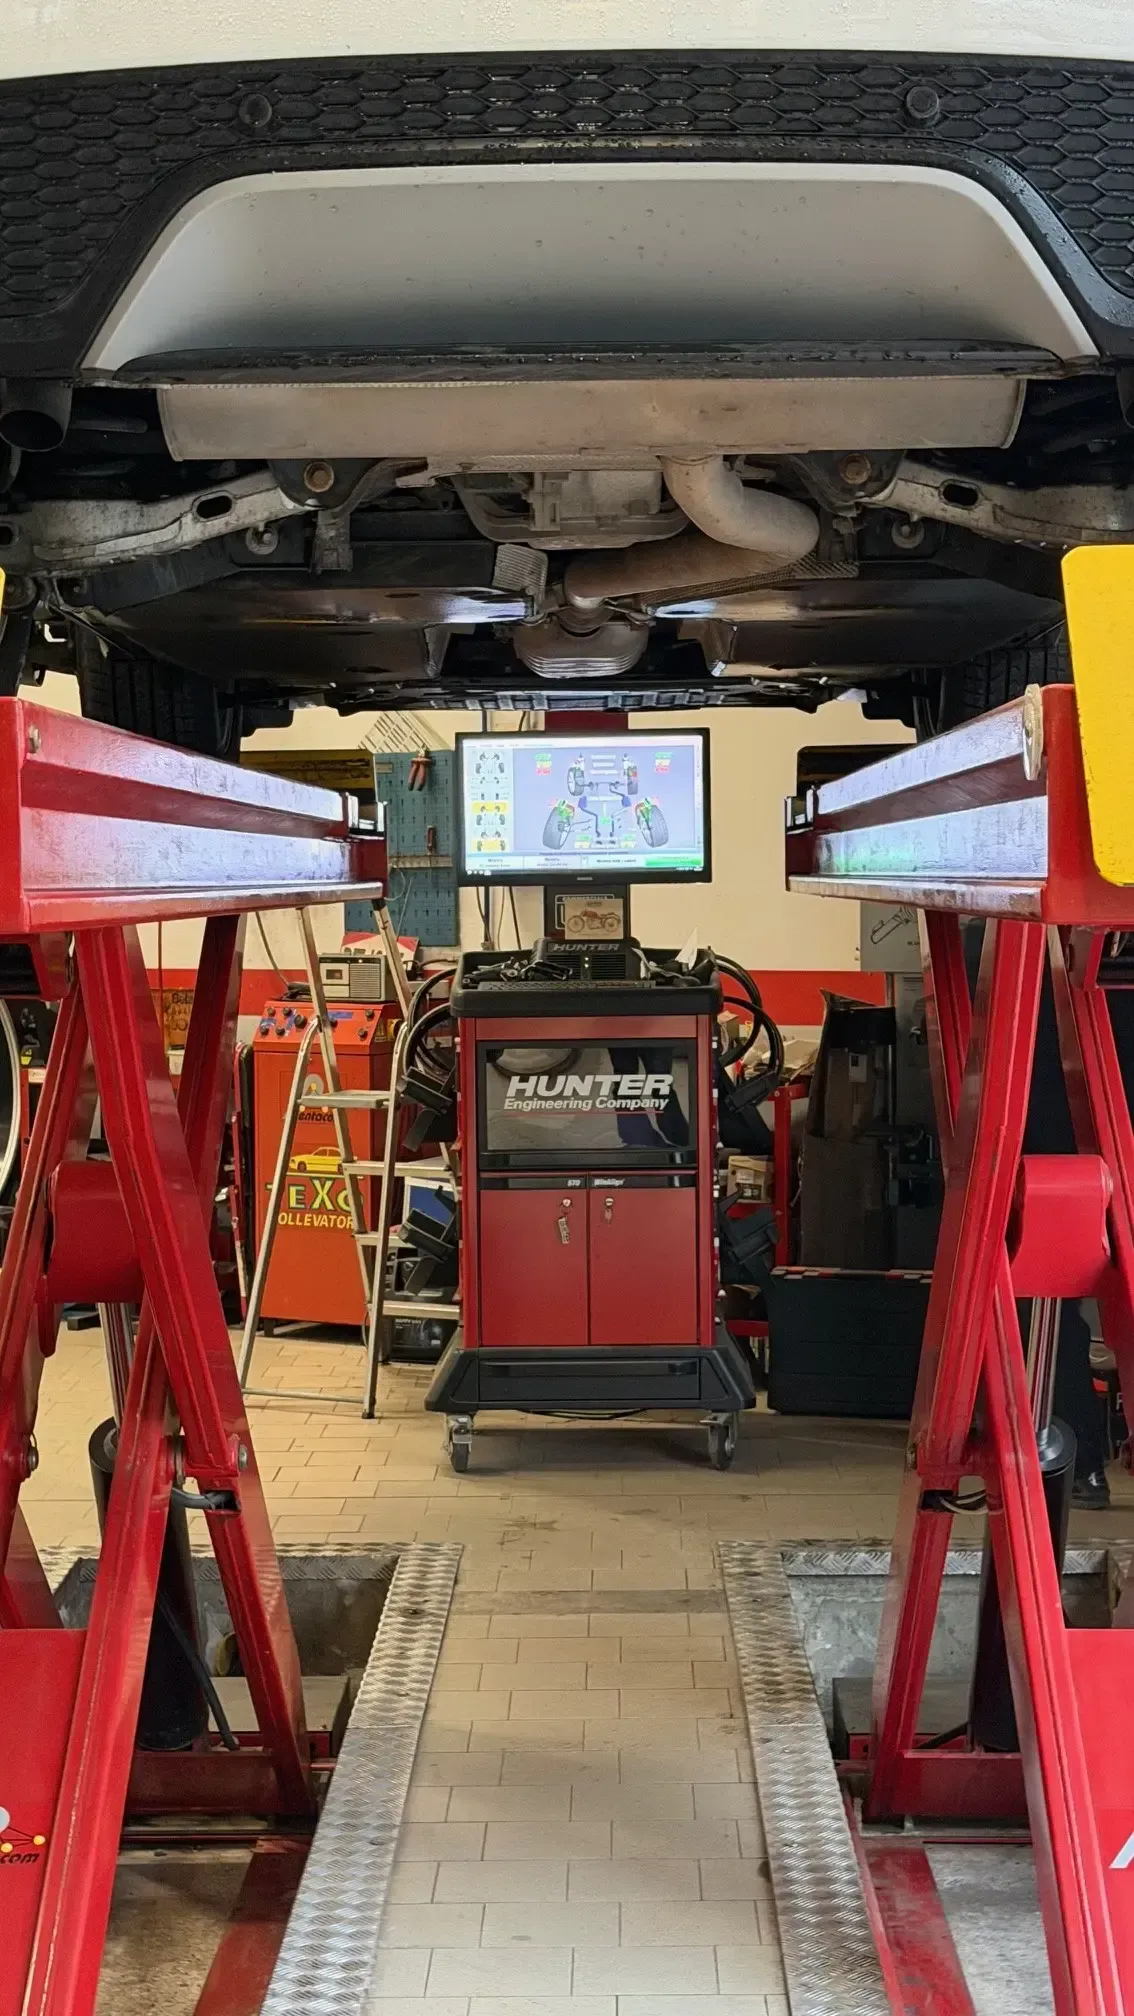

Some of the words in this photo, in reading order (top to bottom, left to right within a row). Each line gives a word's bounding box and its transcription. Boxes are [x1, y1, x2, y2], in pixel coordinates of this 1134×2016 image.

[553, 943, 620, 951] HUNTER
[507, 1075, 673, 1096] HUNTER
[504, 1098, 592, 1111] Engineering
[595, 1096, 669, 1110] Company
[265, 1177, 364, 1212] EXO
[277, 1212, 354, 1229] OLLEVATOR
